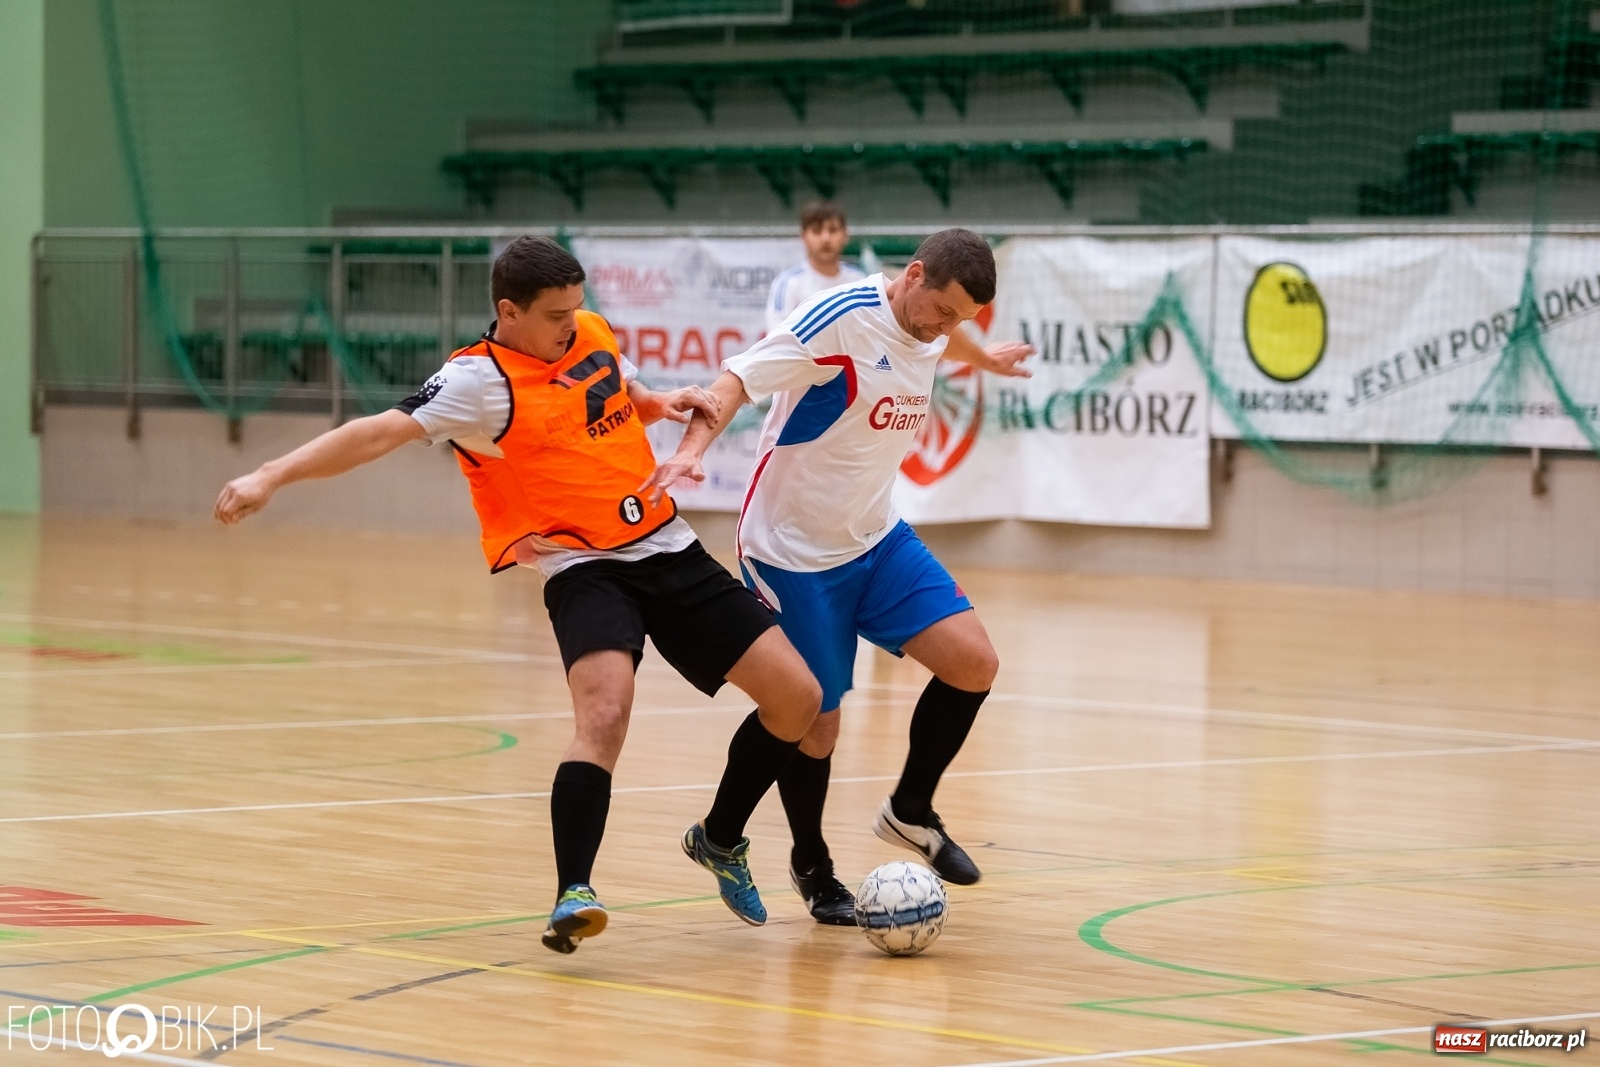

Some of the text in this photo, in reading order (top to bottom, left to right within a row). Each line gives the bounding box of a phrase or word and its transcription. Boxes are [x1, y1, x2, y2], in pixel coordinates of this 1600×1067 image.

[711, 266, 779, 290] WOR
[1020, 318, 1172, 367] MIASTO
[1347, 351, 1407, 406] JEST
[1414, 335, 1441, 372] W
[586, 402, 633, 441] PATRICK
[999, 376, 1198, 437] RACIBÓRZ
[623, 496, 641, 523] 6
